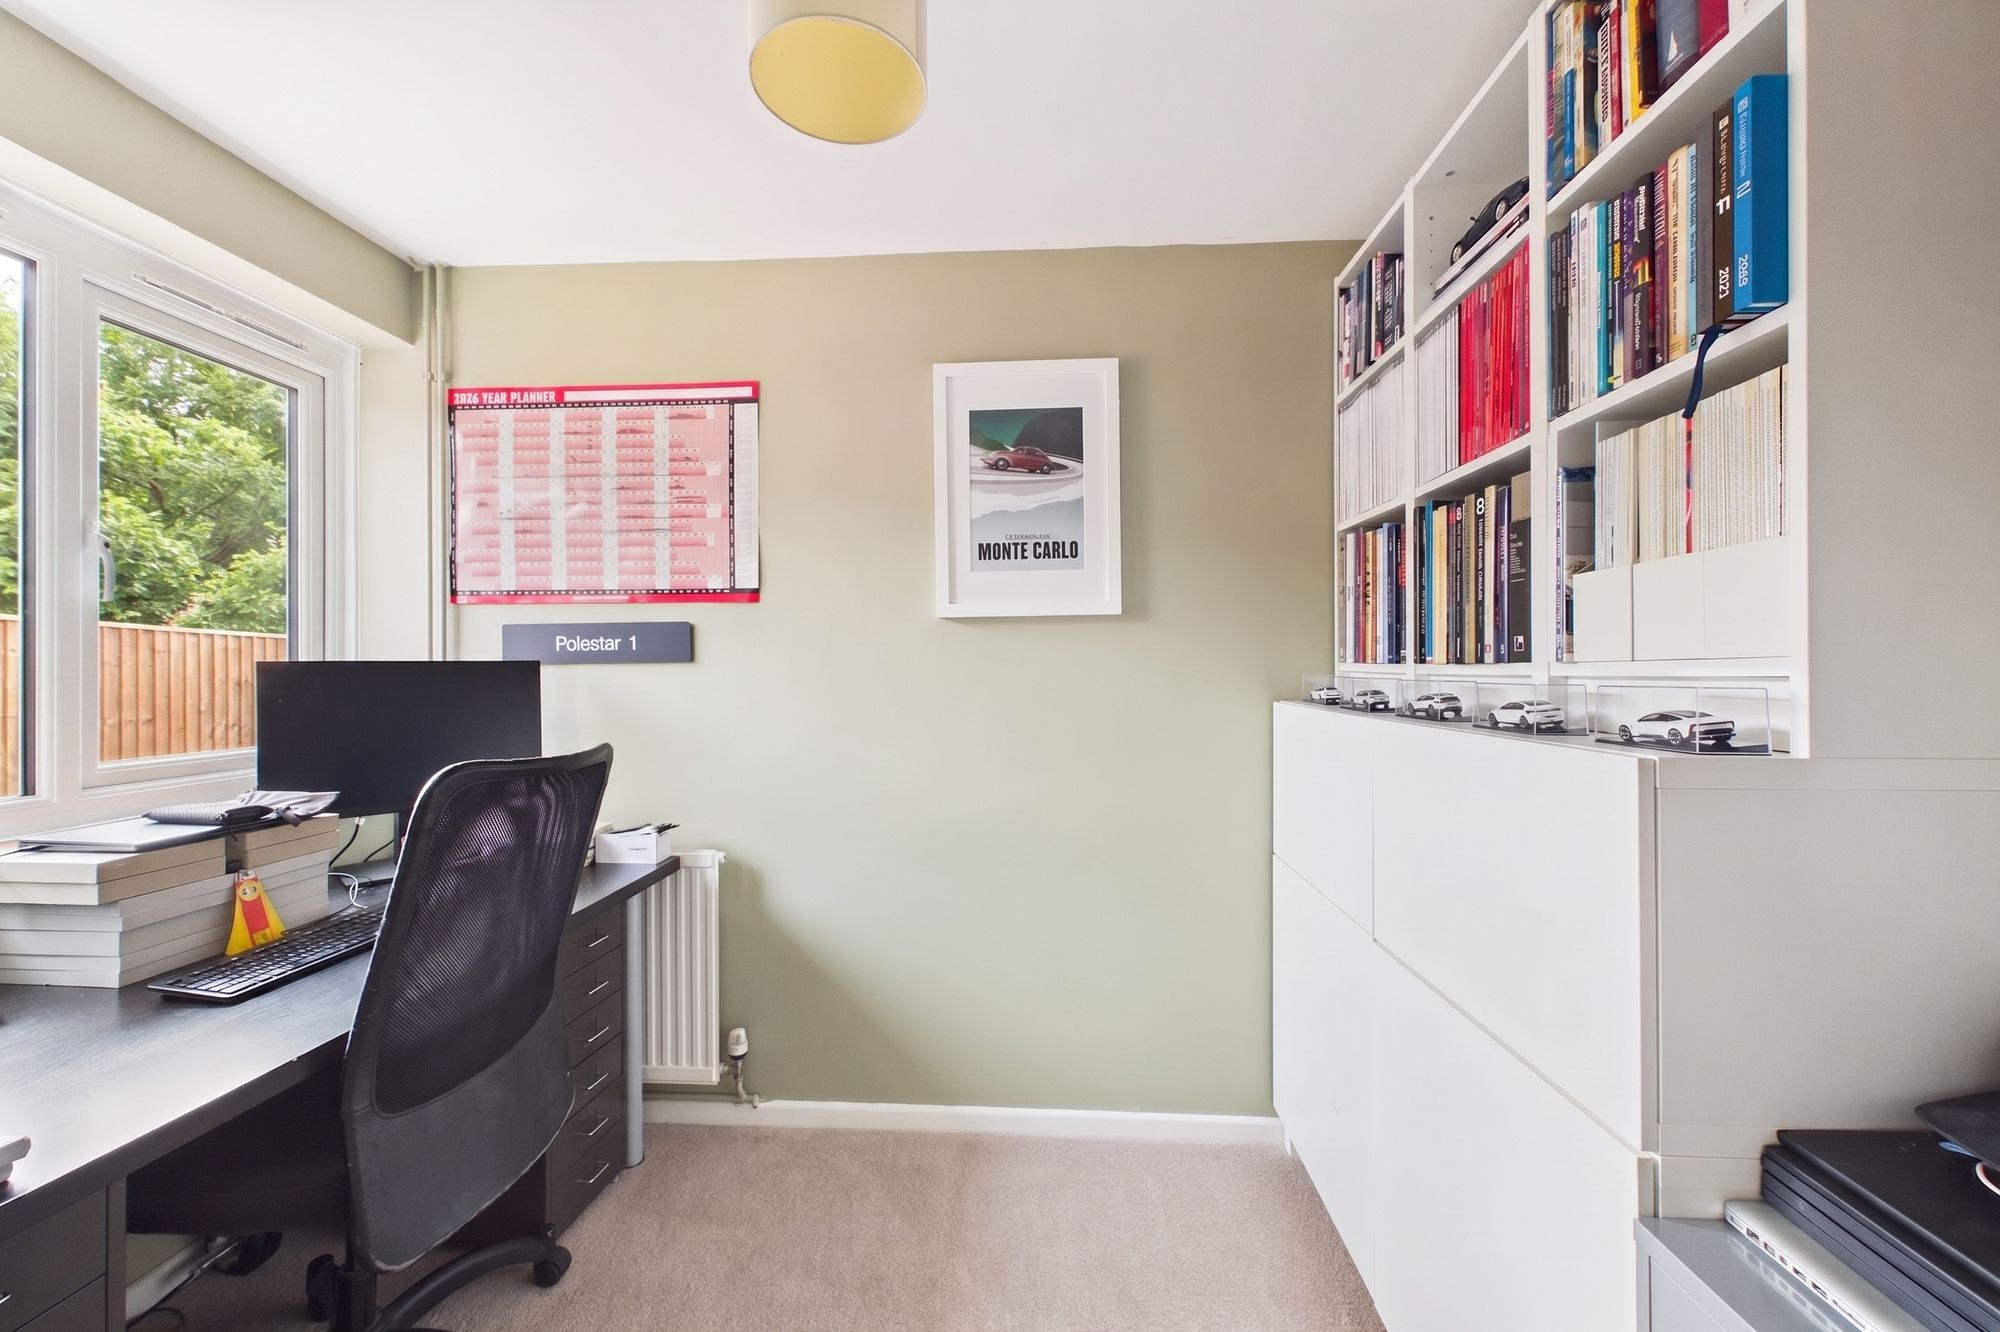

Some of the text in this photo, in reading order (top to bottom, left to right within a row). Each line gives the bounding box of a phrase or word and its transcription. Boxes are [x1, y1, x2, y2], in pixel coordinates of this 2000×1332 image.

[1719, 266, 1730, 299] 2021
[482, 391, 508, 404] YEAR
[510, 390, 556, 403] PLANNER
[978, 540, 1079, 561] MONTE CARLO
[555, 634, 637, 652] Polestar 1
